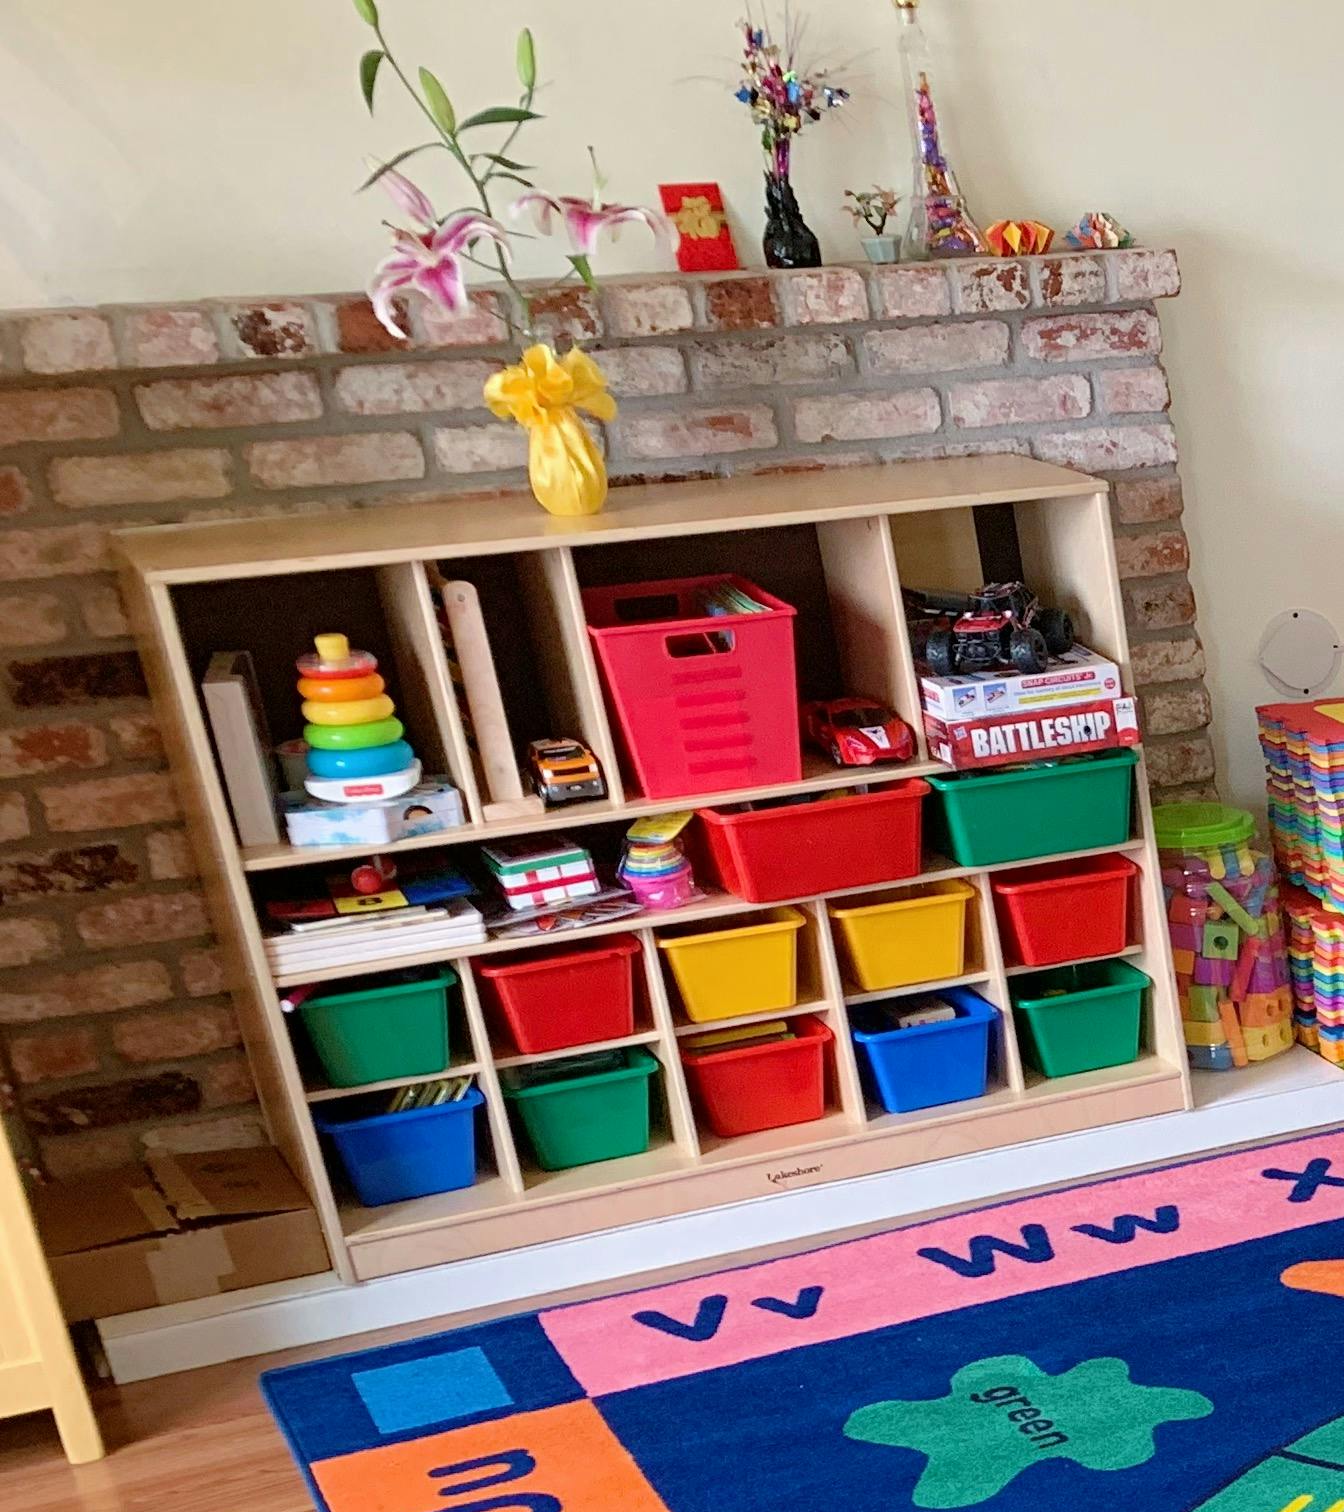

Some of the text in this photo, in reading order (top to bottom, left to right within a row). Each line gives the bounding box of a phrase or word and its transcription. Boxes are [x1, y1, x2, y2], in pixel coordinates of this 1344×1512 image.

[970, 711, 1111, 758] BATTLESHIP
[632, 1286, 823, 1341] Vv
[917, 1205, 1179, 1277] Ww
[970, 1384, 1070, 1452] green
